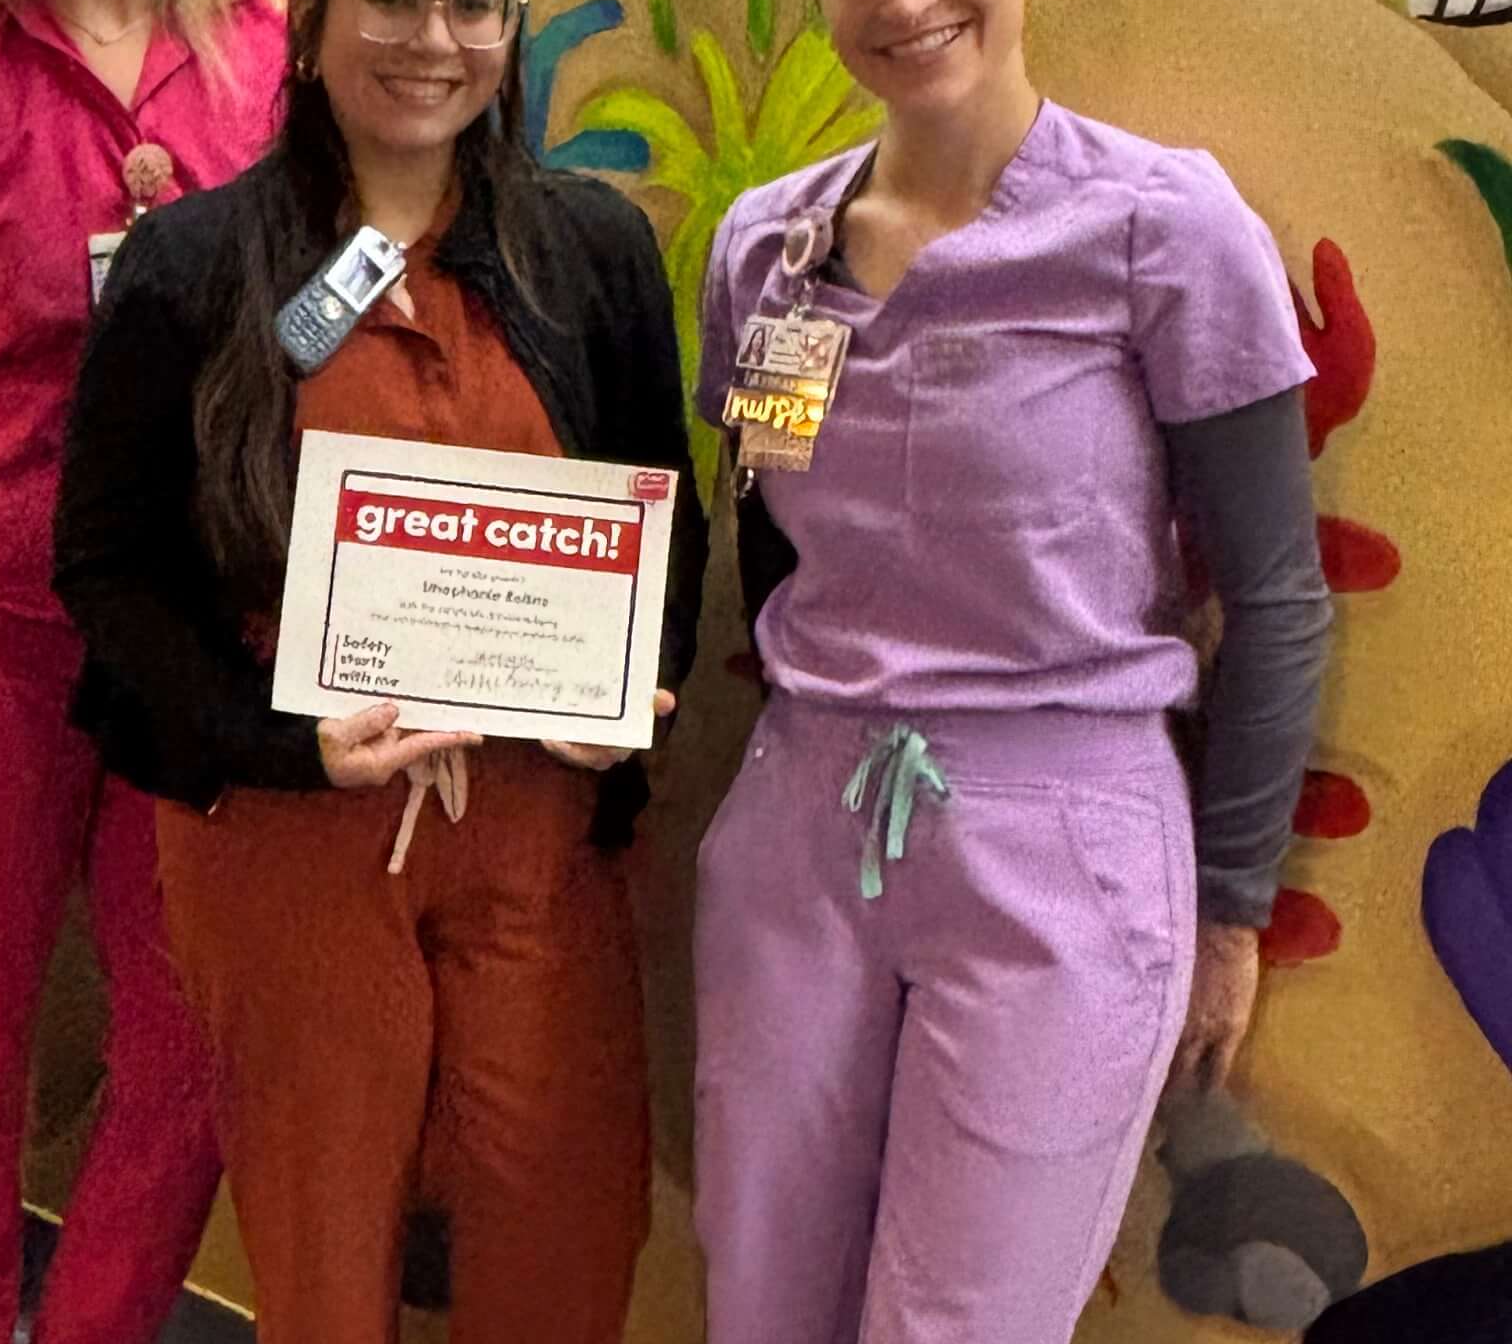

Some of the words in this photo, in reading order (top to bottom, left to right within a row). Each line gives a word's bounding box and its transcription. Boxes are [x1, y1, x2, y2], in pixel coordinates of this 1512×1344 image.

[731, 394, 806, 429] nurse
[356, 504, 478, 543] great
[485, 516, 621, 560] catch!
[342, 634, 392, 656] Safety
